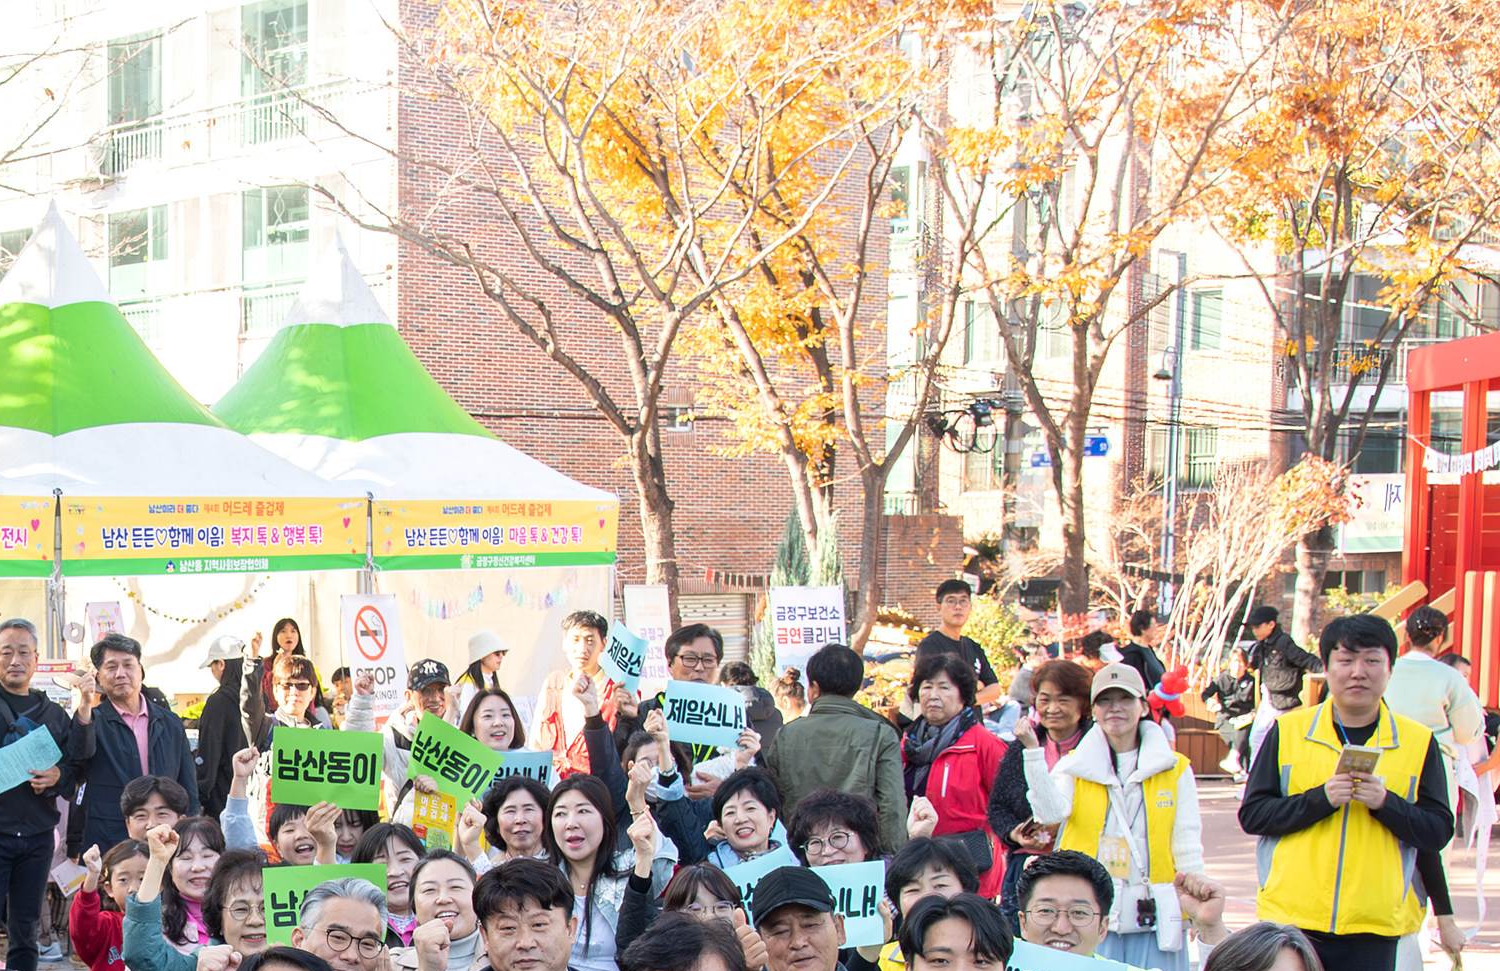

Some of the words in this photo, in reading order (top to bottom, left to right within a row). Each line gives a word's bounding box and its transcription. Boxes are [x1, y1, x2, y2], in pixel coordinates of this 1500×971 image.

[223, 501, 252, 516] 머드레
[1, 527, 27, 549] 전시
[102, 527, 128, 549] 남산
[197, 526, 224, 547] 이음!
[231, 526, 254, 546] 복지
[257, 526, 267, 546] 톡
[270, 527, 280, 543] &
[283, 525, 305, 546] 행복
[405, 528, 427, 547] 남산
[482, 527, 504, 545] 이음!
[509, 527, 527, 544] 마음
[541, 528, 548, 542] &
[551, 527, 568, 544] 건강
[776, 606, 840, 621] 금정구보건소
[776, 626, 842, 644] 금연클리닉
[666, 698, 743, 729] 제일신나!
[277, 749, 377, 785] 남산동이
[411, 731, 490, 794] 남산동이
